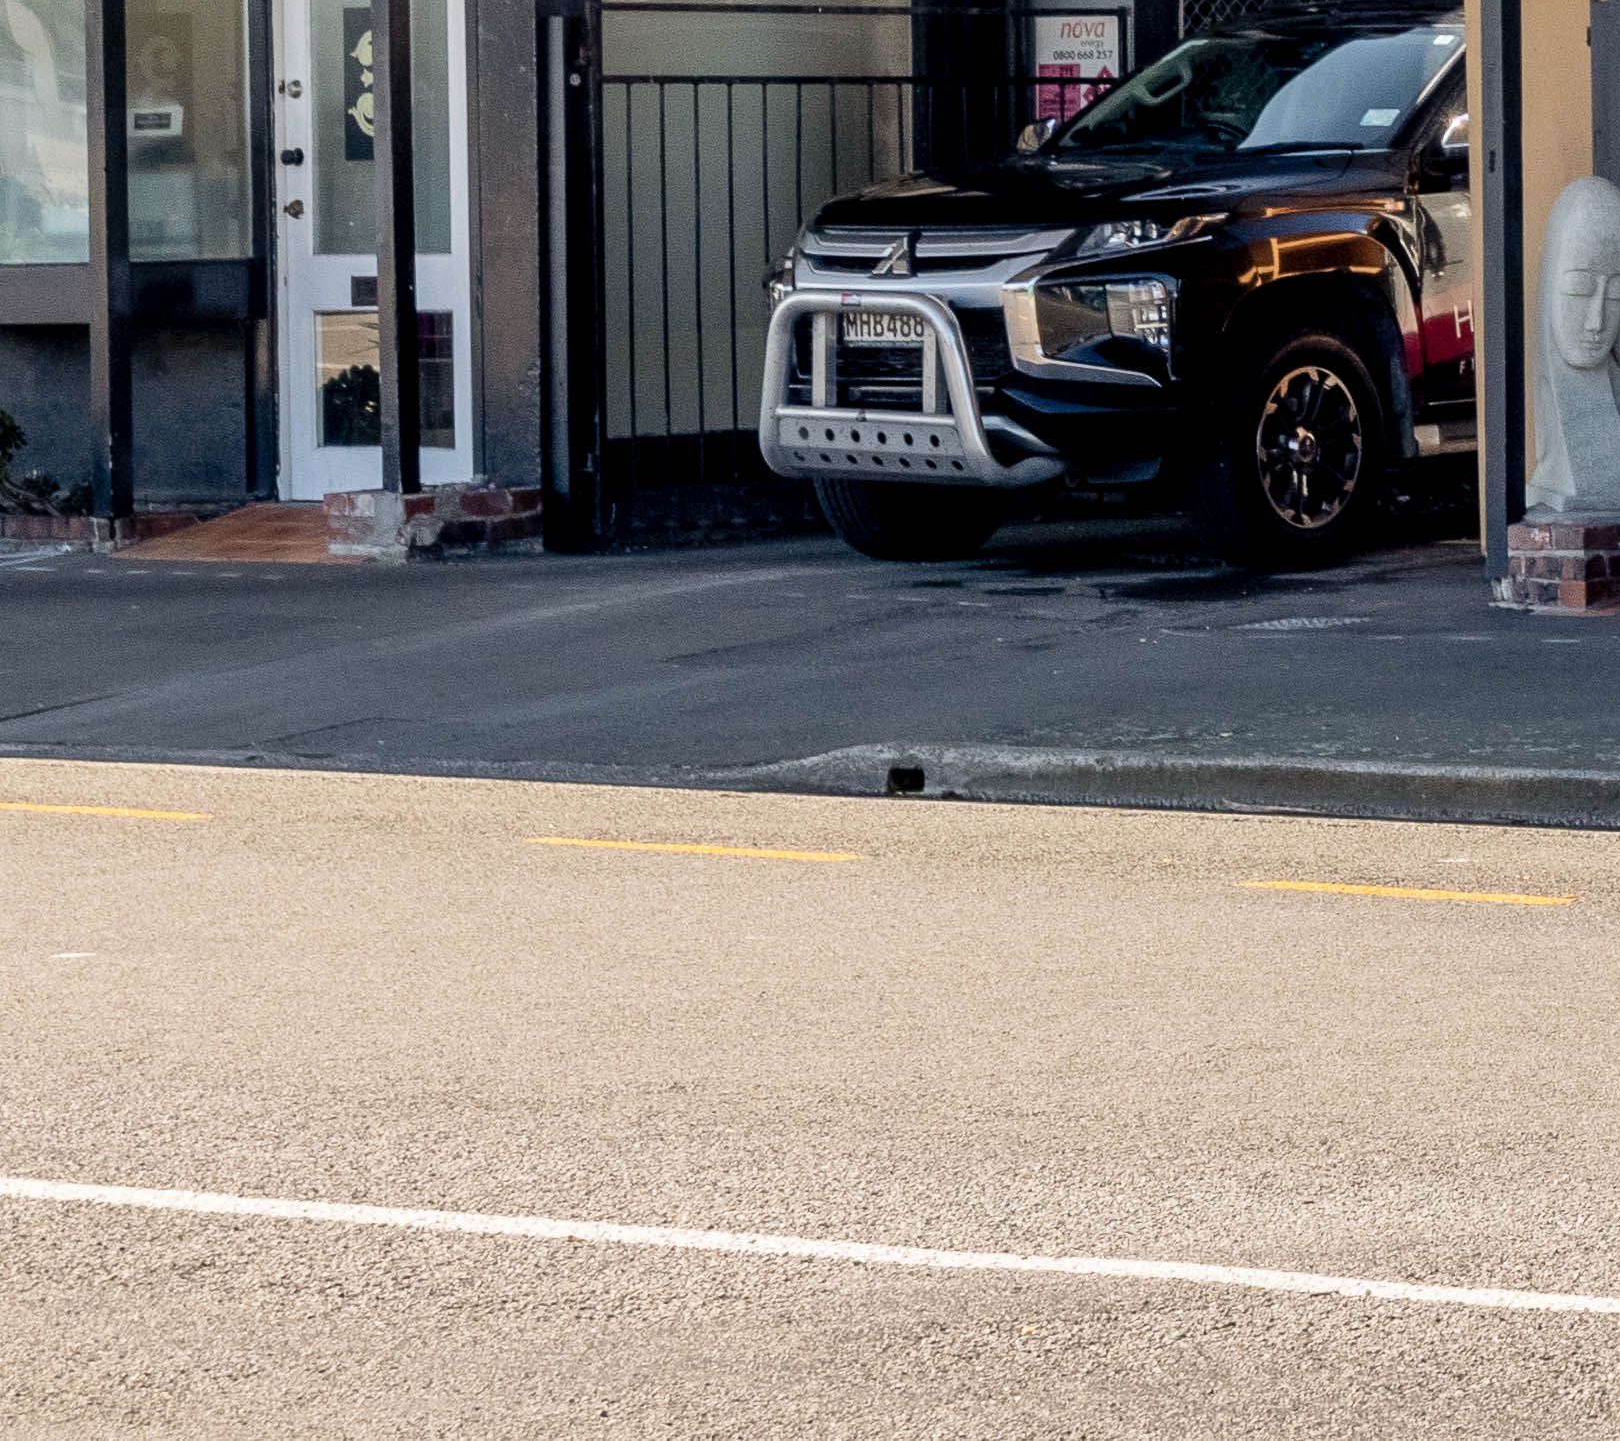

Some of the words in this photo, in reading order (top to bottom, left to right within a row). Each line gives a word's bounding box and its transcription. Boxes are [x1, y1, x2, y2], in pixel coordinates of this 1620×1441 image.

[1060, 21, 1105, 39] nova
[1053, 50, 1076, 61] 0800
[1077, 50, 1095, 60] 668
[1097, 49, 1114, 60] 257
[844, 310, 925, 338] MHB488
